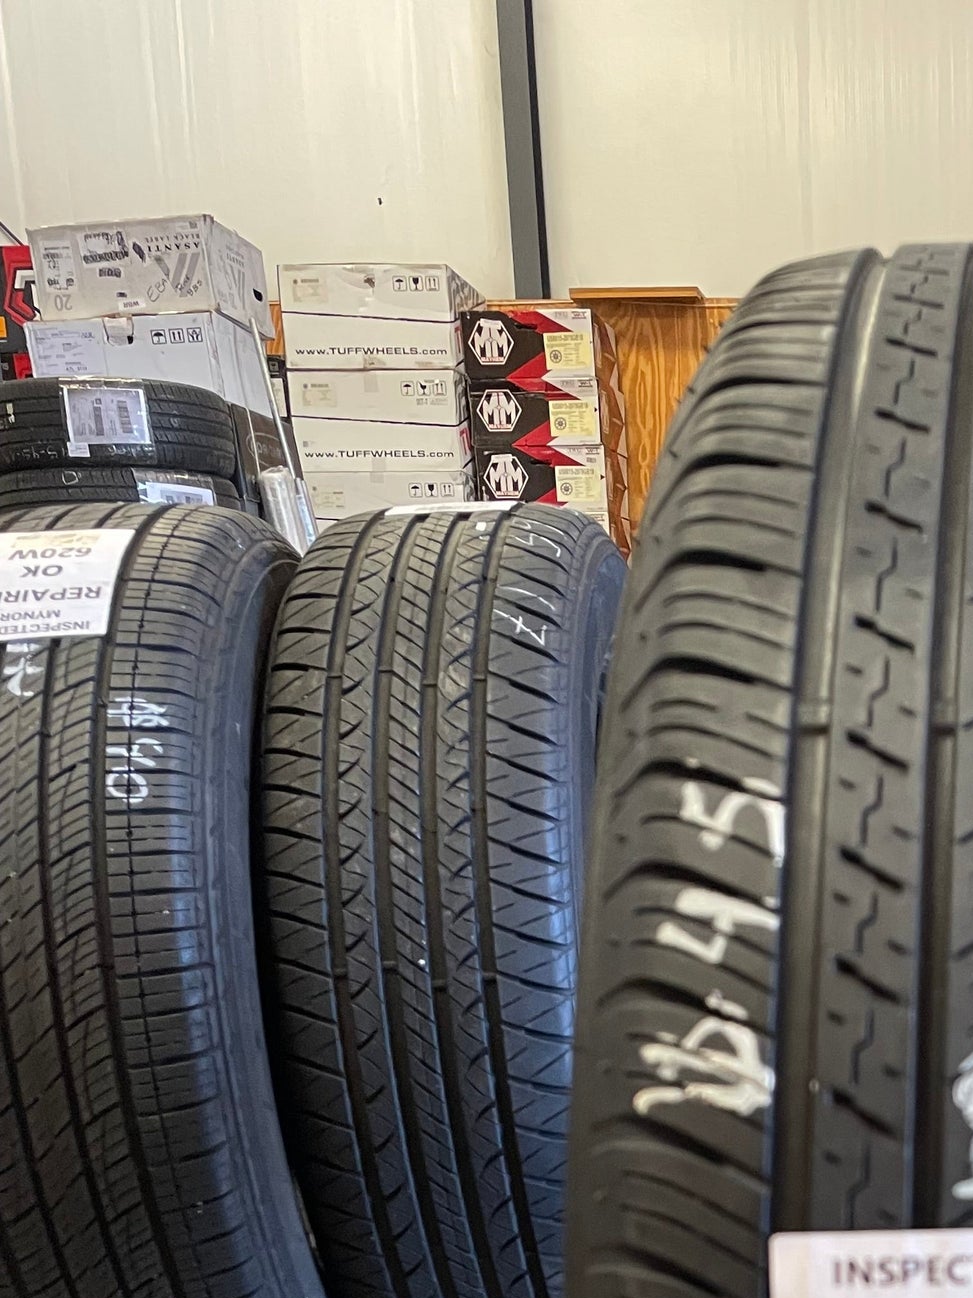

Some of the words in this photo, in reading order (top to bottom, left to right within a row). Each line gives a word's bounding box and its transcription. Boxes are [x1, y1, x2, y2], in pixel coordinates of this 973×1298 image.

[147, 241, 201, 253] ASANTI
[53, 294, 73, 311] 20
[295, 346, 448, 356] www.TUFFWHEELS.com
[304, 449, 455, 459] www.TUFFWHEELS.com
[8, 547, 92, 561] 620W
[19, 565, 63, 578] OK
[0, 586, 102, 604] REPAIR
